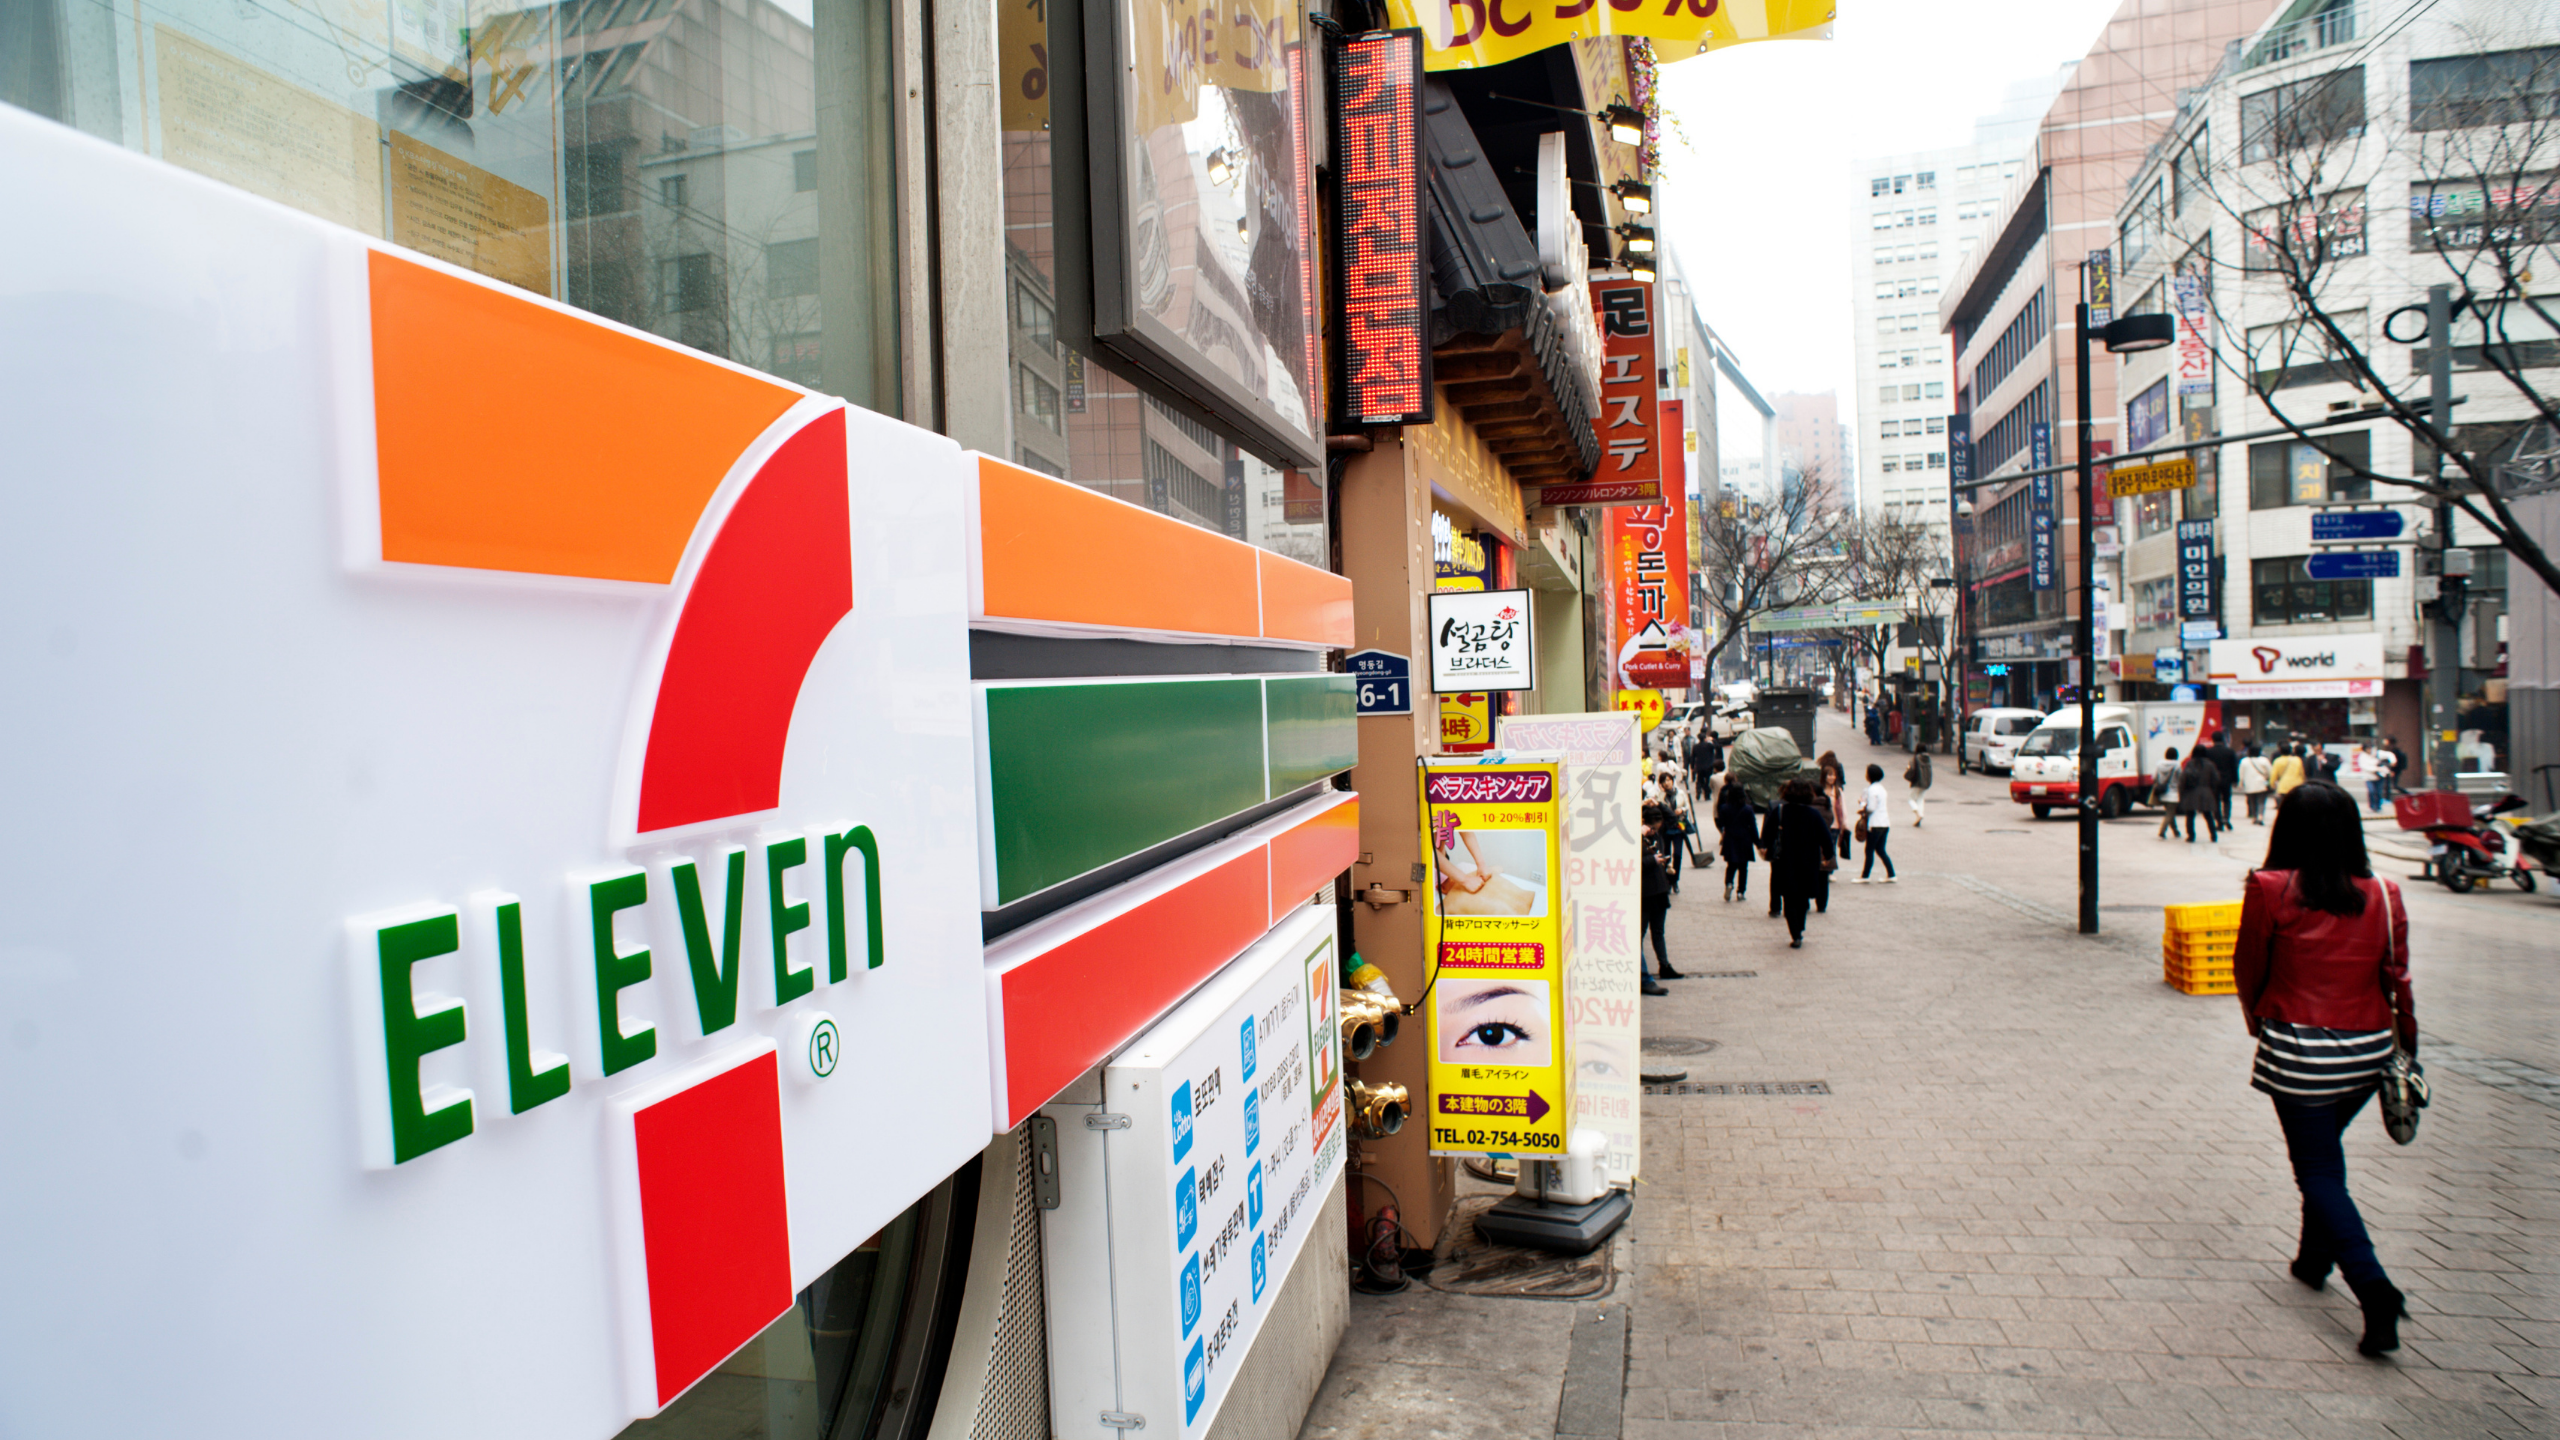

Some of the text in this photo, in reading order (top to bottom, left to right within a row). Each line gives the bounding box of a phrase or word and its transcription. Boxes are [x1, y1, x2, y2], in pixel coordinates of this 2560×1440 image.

[1345, 36, 1421, 416] 커피전문점
[2177, 316, 2209, 379] 부동산
[2036, 533, 2050, 586] 제주은행
[2184, 544, 2210, 614] 미인의원
[1440, 617, 1520, 653] 설곰탕
[1358, 660, 1384, 670] 명동길
[1450, 656, 1512, 671] 브라더스
[1665, 662, 1681, 670] Curry
[2286, 651, 2335, 667] world
[1356, 682, 1400, 707] 6-1
[1428, 775, 1550, 800] ベラスキンケア
[1428, 810, 1462, 850] 背
[1444, 919, 1540, 931] 背中アロママッサージ
[1445, 946, 1537, 965] 24時間営業
[1261, 1071, 1276, 1105] Korea
[1277, 1056, 1288, 1086] pass
[1289, 1039, 1300, 1068] card
[1195, 1065, 1221, 1118] 로또판매
[1445, 1096, 1528, 1115] 本建物の3階
[1173, 1114, 1192, 1145] Lotto
[1435, 1128, 1560, 1148] TEL. 02-754-5050
[1199, 1153, 1225, 1205] 택배접수
[1203, 1199, 1245, 1285] 쓰레기봉투판매
[1268, 1205, 1288, 1259] 관광상품
[1207, 1297, 1239, 1374] 휴대폰충전
